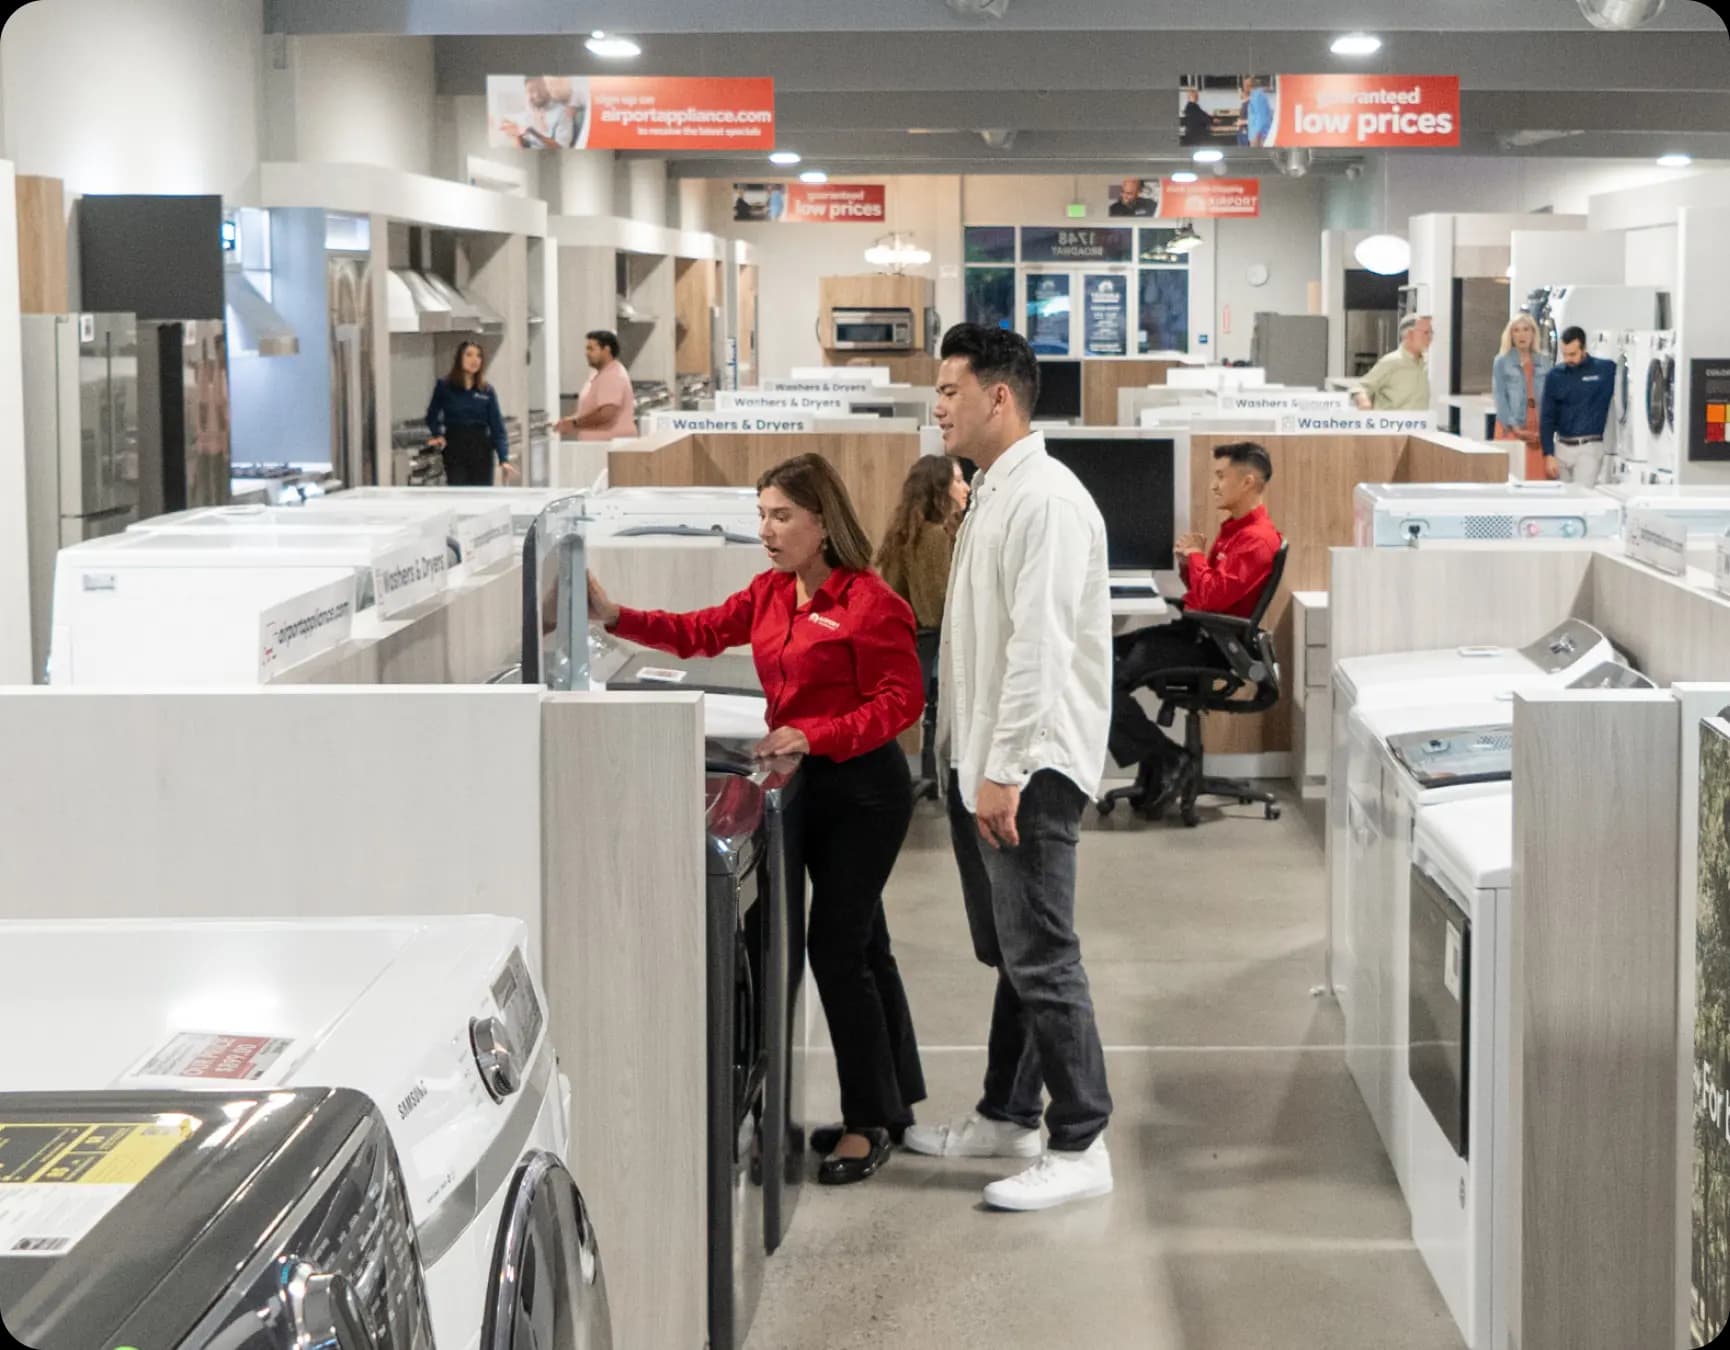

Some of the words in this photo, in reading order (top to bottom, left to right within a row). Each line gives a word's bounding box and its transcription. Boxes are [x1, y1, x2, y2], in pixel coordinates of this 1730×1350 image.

[601, 107, 772, 126] airportappliance.com
[1294, 104, 1352, 134] low
[1356, 106, 1453, 141] prices
[796, 200, 826, 216] low
[829, 200, 882, 220] prices
[734, 397, 787, 408] Washers
[790, 397, 798, 408] &
[801, 398, 841, 411] Dryers
[1236, 398, 1288, 408] Washers
[673, 418, 738, 431] Washers
[742, 419, 751, 431] &
[755, 419, 804, 433] Dryers
[1298, 416, 1361, 429] Washers
[1365, 418, 1375, 429] &
[1379, 418, 1427, 432] Dryers
[1702, 1059, 1724, 1129] For
